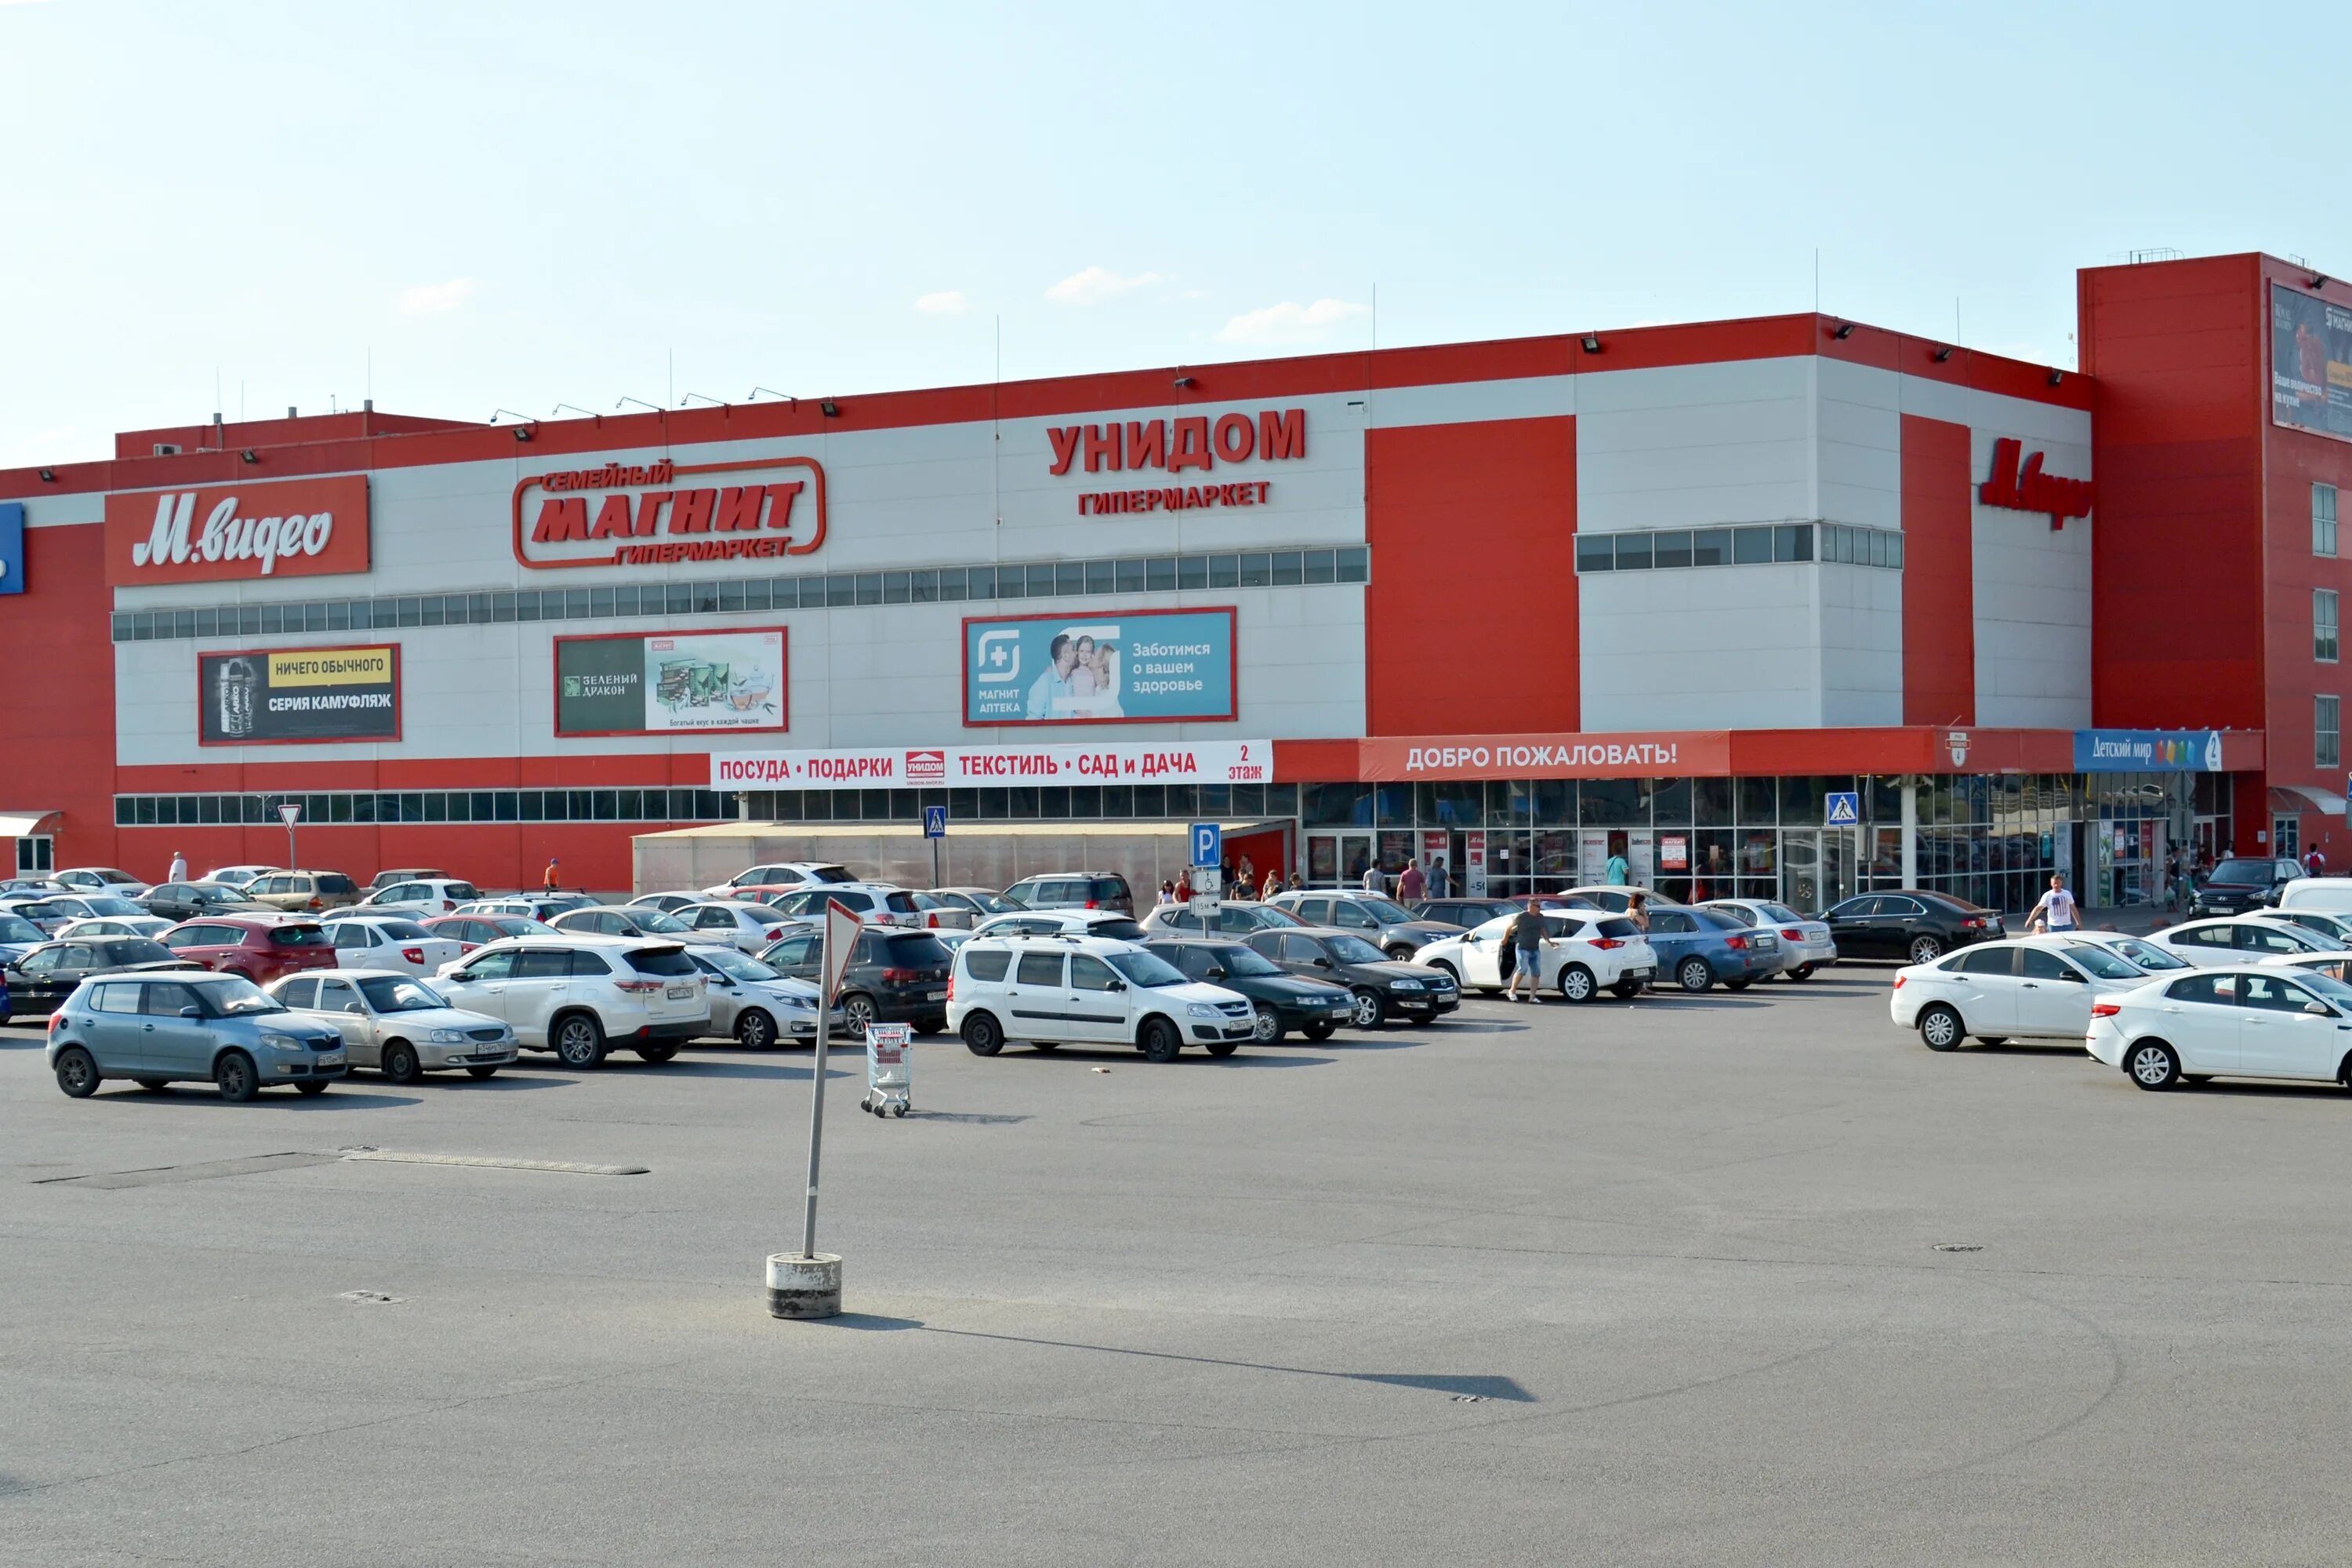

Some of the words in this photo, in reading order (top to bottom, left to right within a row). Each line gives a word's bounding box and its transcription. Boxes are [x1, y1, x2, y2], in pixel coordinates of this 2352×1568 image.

[1047, 408, 1305, 475] УНИДОМ
[542, 459, 673, 492] СЕМЕЙНЫЙ
[1078, 481, 1269, 515] ГИПЕРМАРКЕТ
[532, 481, 804, 542] МАГНИТ
[132, 493, 332, 575] М.видео
[614, 536, 792, 564] ГИПЕРМАРКЕТ
[1133, 643, 1210, 657] Заботимся
[276, 661, 318, 676] НИЧЕГО
[321, 658, 383, 673] ОБЫЧНОГО
[1133, 664, 1142, 674] о
[1145, 662, 1193, 673] вашем
[583, 673, 637, 686] ЗЕЛЕНЫЙ
[1133, 680, 1203, 695] здоровье
[583, 686, 626, 698] ДРАКОН
[978, 689, 1019, 699] МАГНИТ
[269, 697, 310, 712] СЕРИЯ
[312, 694, 391, 710] КАМУФЛЯЖ
[979, 703, 1021, 713] АПТЕКА
[1240, 745, 1248, 761] 2
[2092, 735, 2131, 758] Детский
[2132, 743, 2152, 765] мир
[2211, 737, 2216, 758] 2
[959, 755, 1058, 775] ТЕКСТИЛЬ
[1078, 754, 1118, 778] САД
[1124, 759, 1134, 774] и
[1142, 753, 1196, 778] ДАЧА
[1406, 746, 1489, 771] ДОБРО
[1497, 743, 1678, 768] ПОЖАЛОВАТЬ!
[720, 760, 789, 782] ПОСУДА
[808, 758, 892, 782] ПОДАРКИ
[907, 762, 943, 772] УНИДОМ
[1228, 765, 1262, 780] этаж
